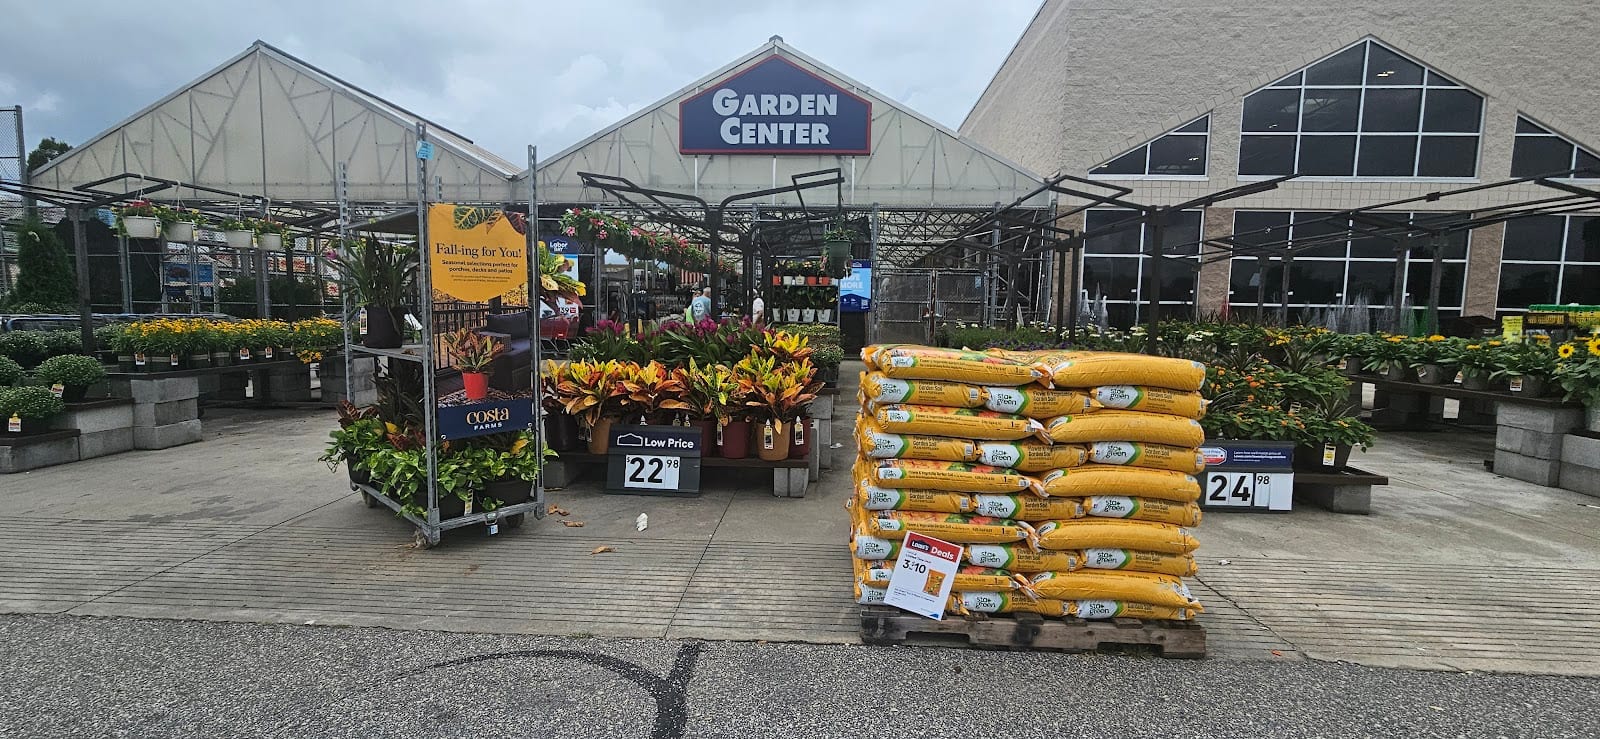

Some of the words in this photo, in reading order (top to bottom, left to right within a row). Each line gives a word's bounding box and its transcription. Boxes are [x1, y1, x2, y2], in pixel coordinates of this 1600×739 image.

[712, 88, 838, 116] GARDEN
[720, 117, 830, 144] CENTER
[436, 243, 478, 258] Fall-ing
[482, 246, 496, 257] for
[499, 247, 522, 258] You!
[466, 407, 509, 424] costa
[474, 422, 502, 430] FARMS
[645, 438, 666, 447] Low
[668, 438, 694, 448] Price
[667, 460, 678, 468] 98
[1210, 475, 1250, 501] 24
[1257, 476, 1270, 484] 98
[931, 546, 954, 560] Deals
[902, 560, 910, 568] 3
